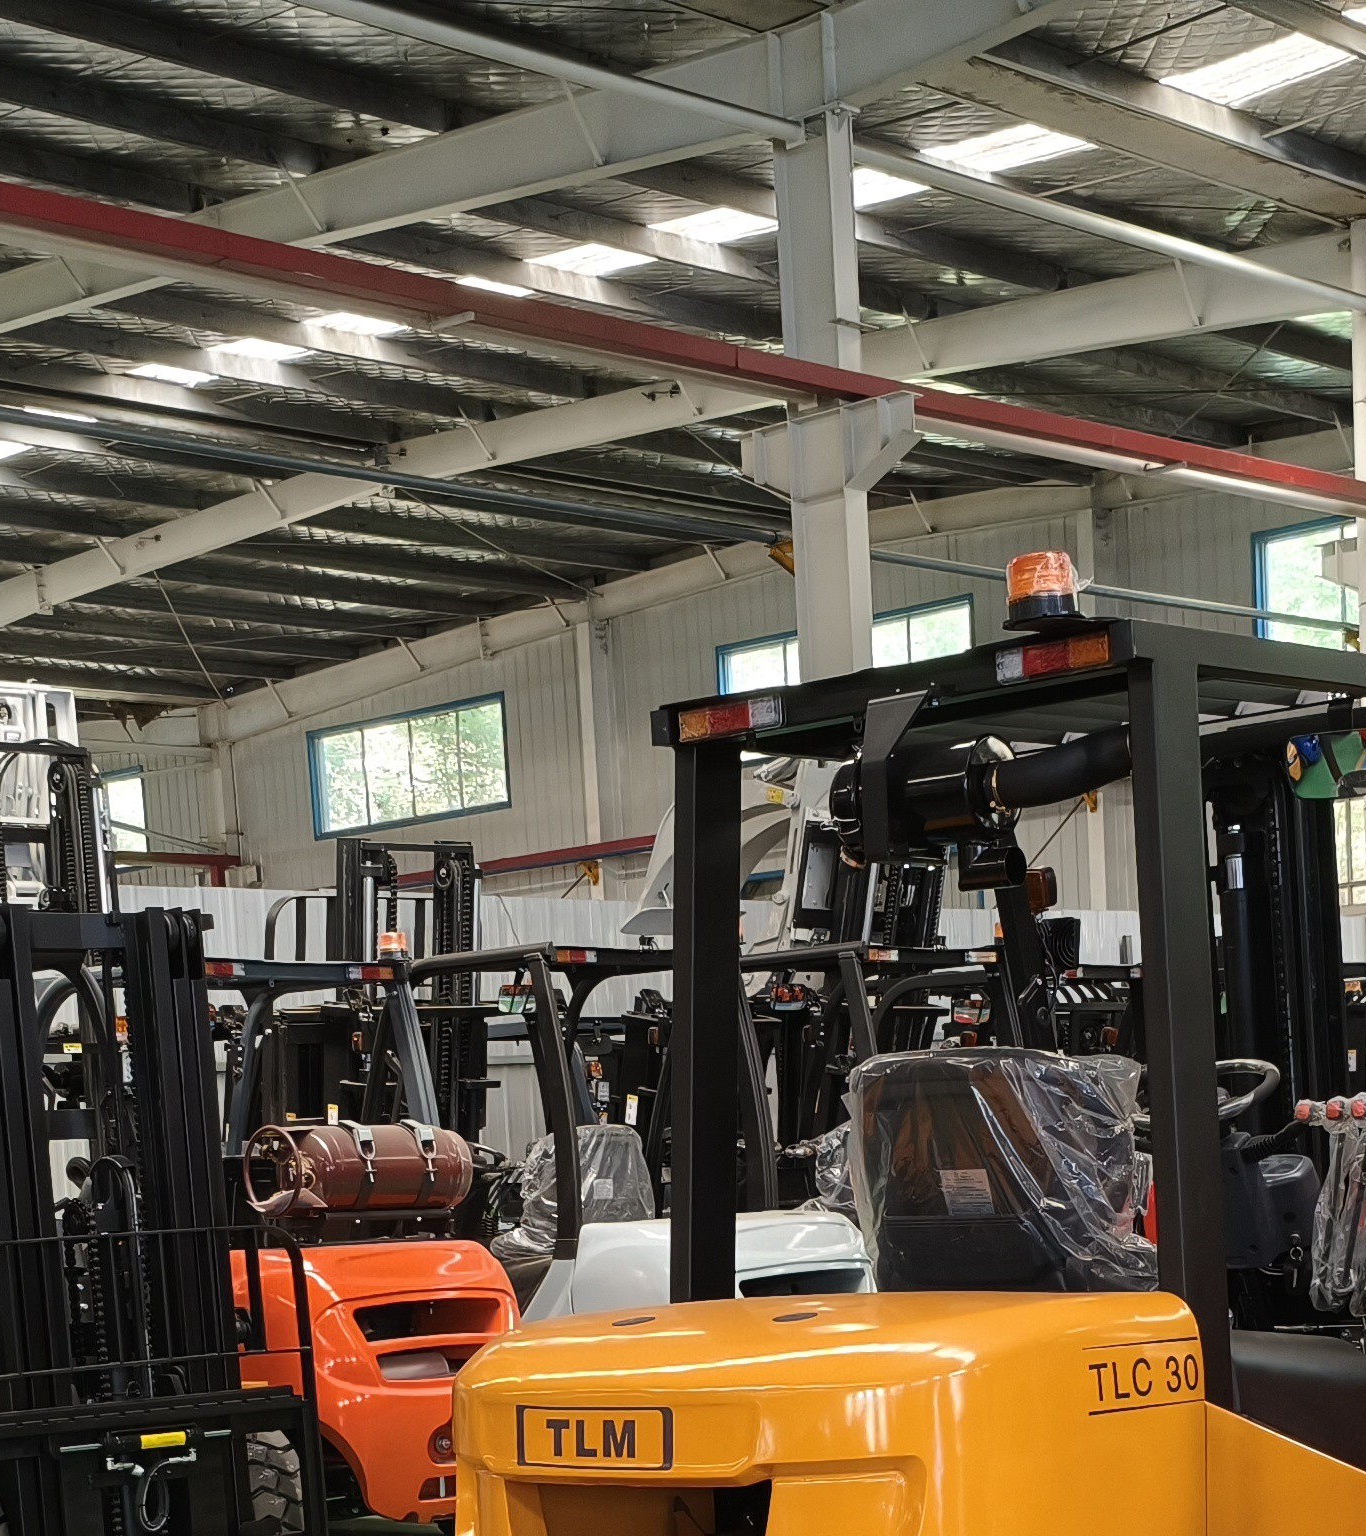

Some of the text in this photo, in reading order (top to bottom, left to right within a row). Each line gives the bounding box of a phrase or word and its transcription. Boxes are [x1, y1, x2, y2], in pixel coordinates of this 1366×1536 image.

[1088, 1353, 1199, 1402] TLC 30
[545, 1418, 636, 1459] TLM
